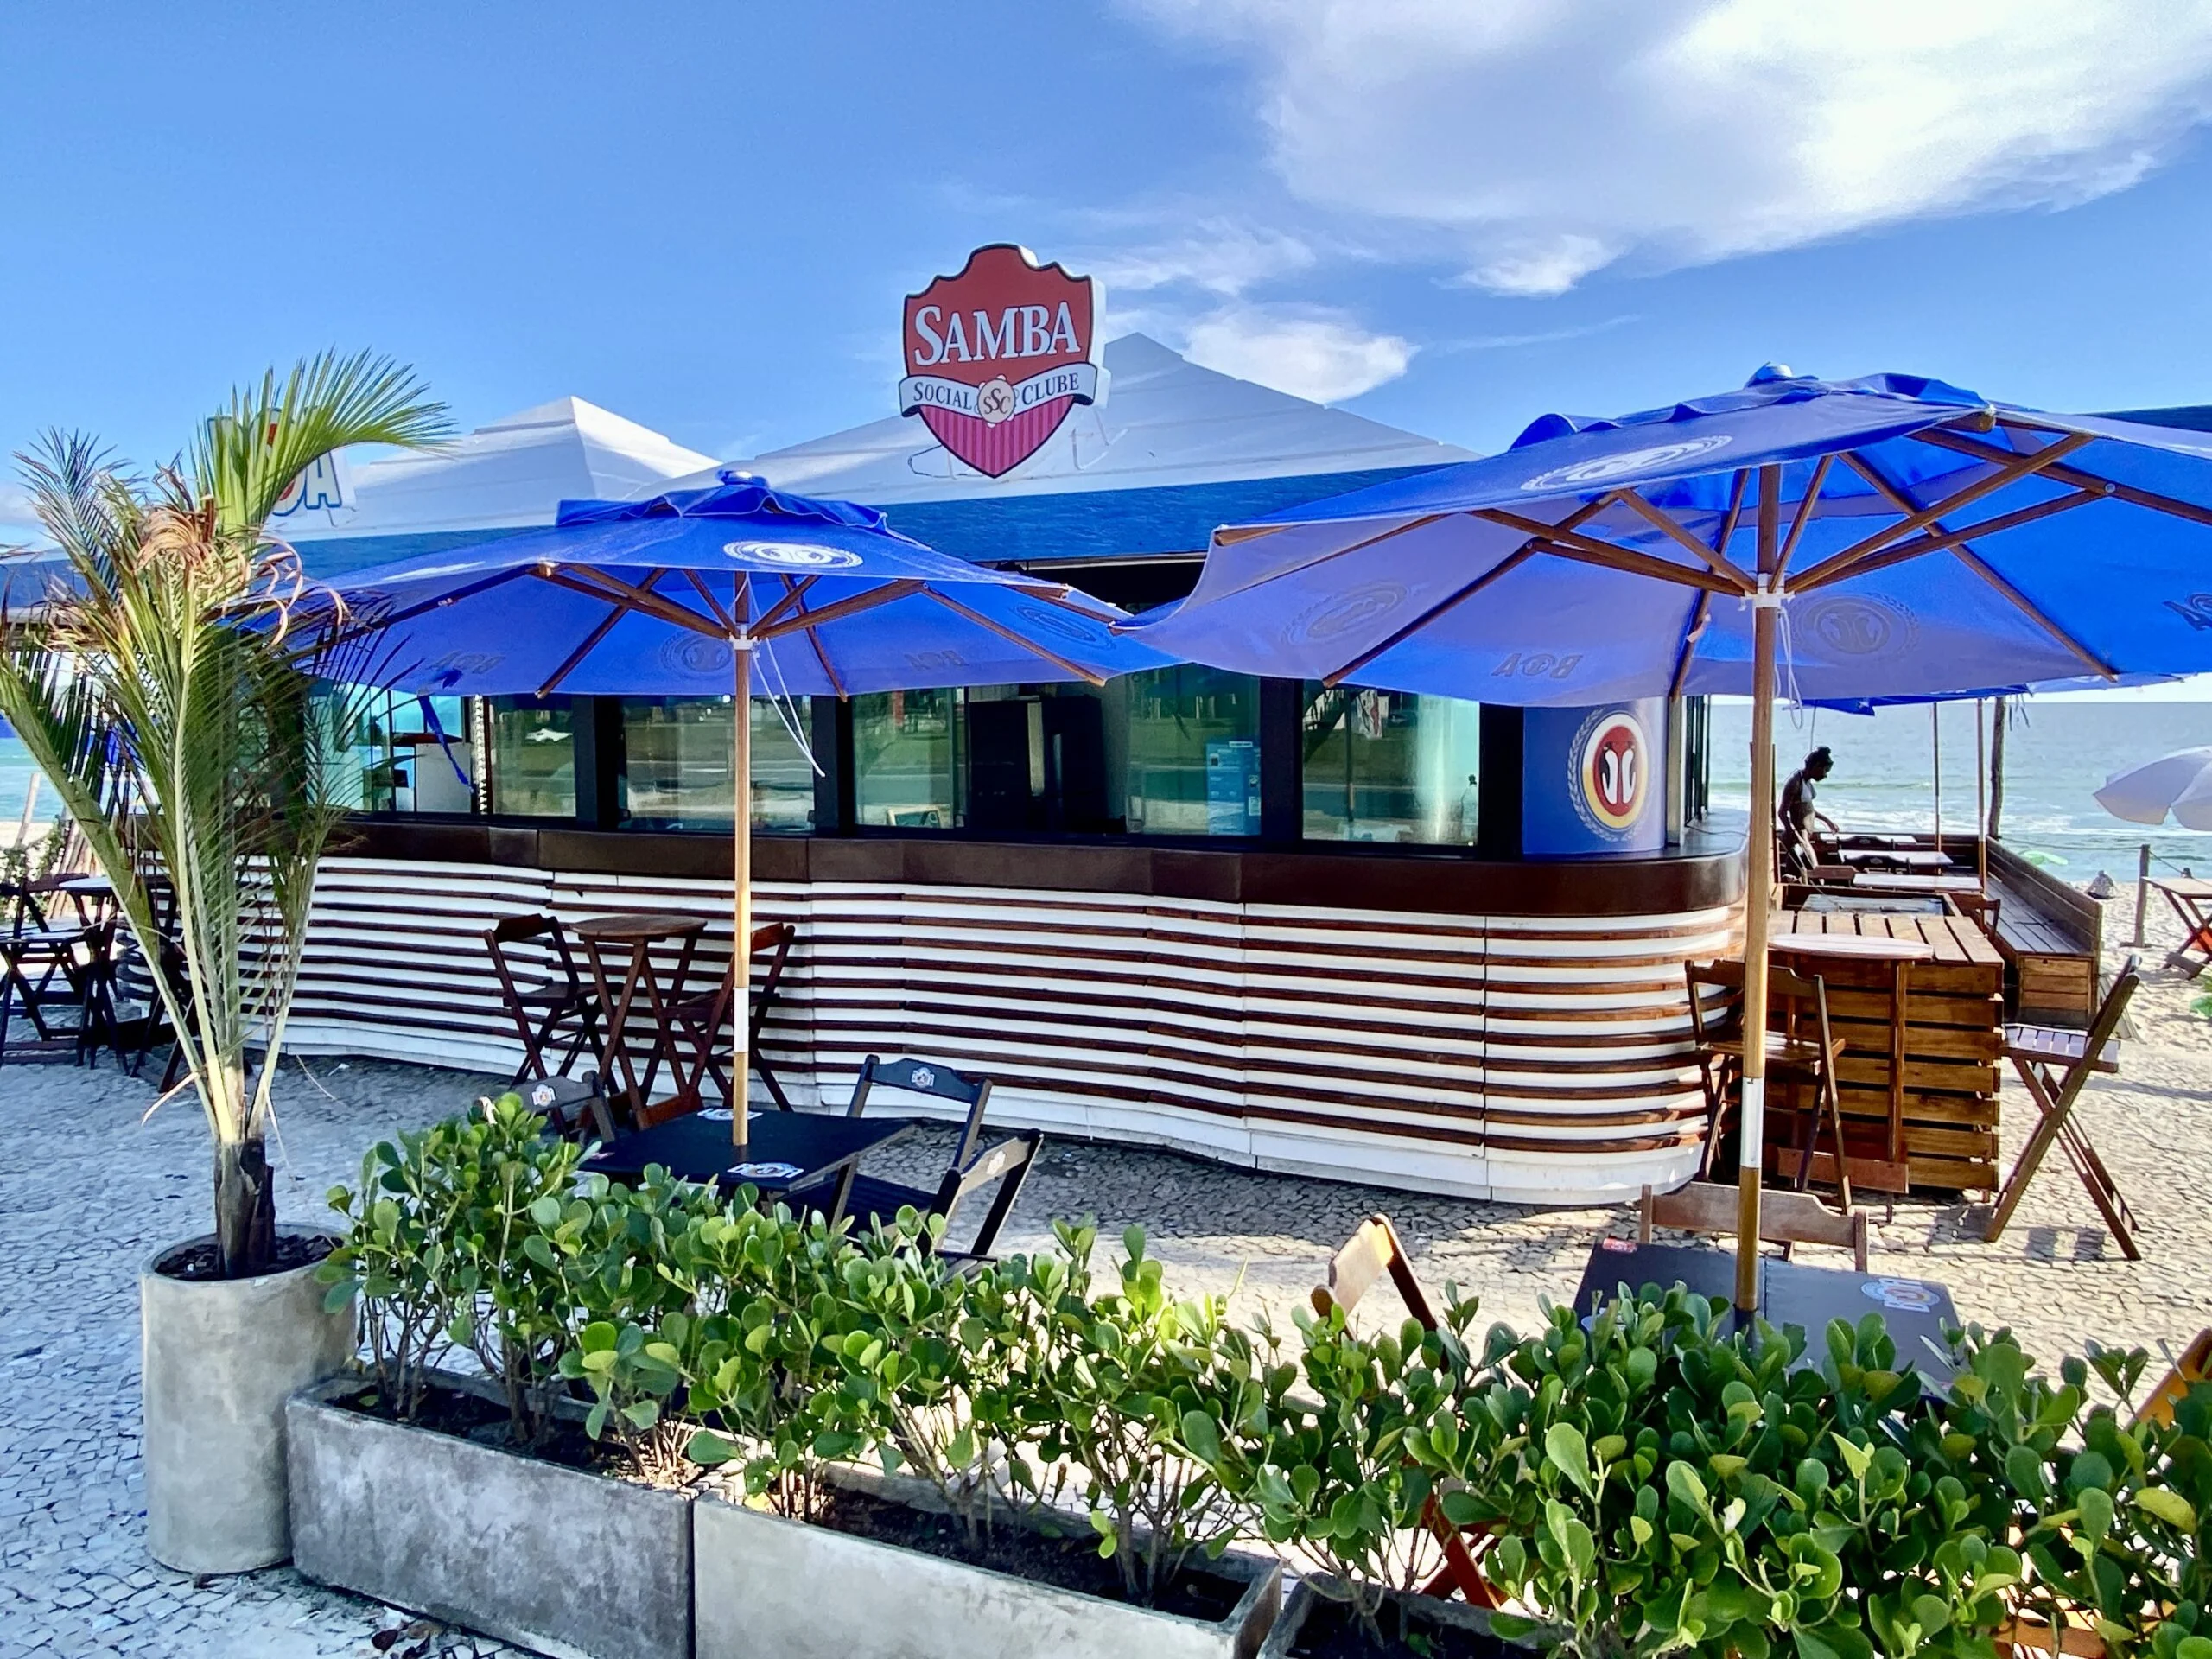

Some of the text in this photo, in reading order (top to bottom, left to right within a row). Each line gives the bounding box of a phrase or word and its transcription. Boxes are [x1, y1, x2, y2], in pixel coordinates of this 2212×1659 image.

[914, 302, 1081, 367] SAMBA
[913, 372, 1079, 410] SOCIAL CLUBE
